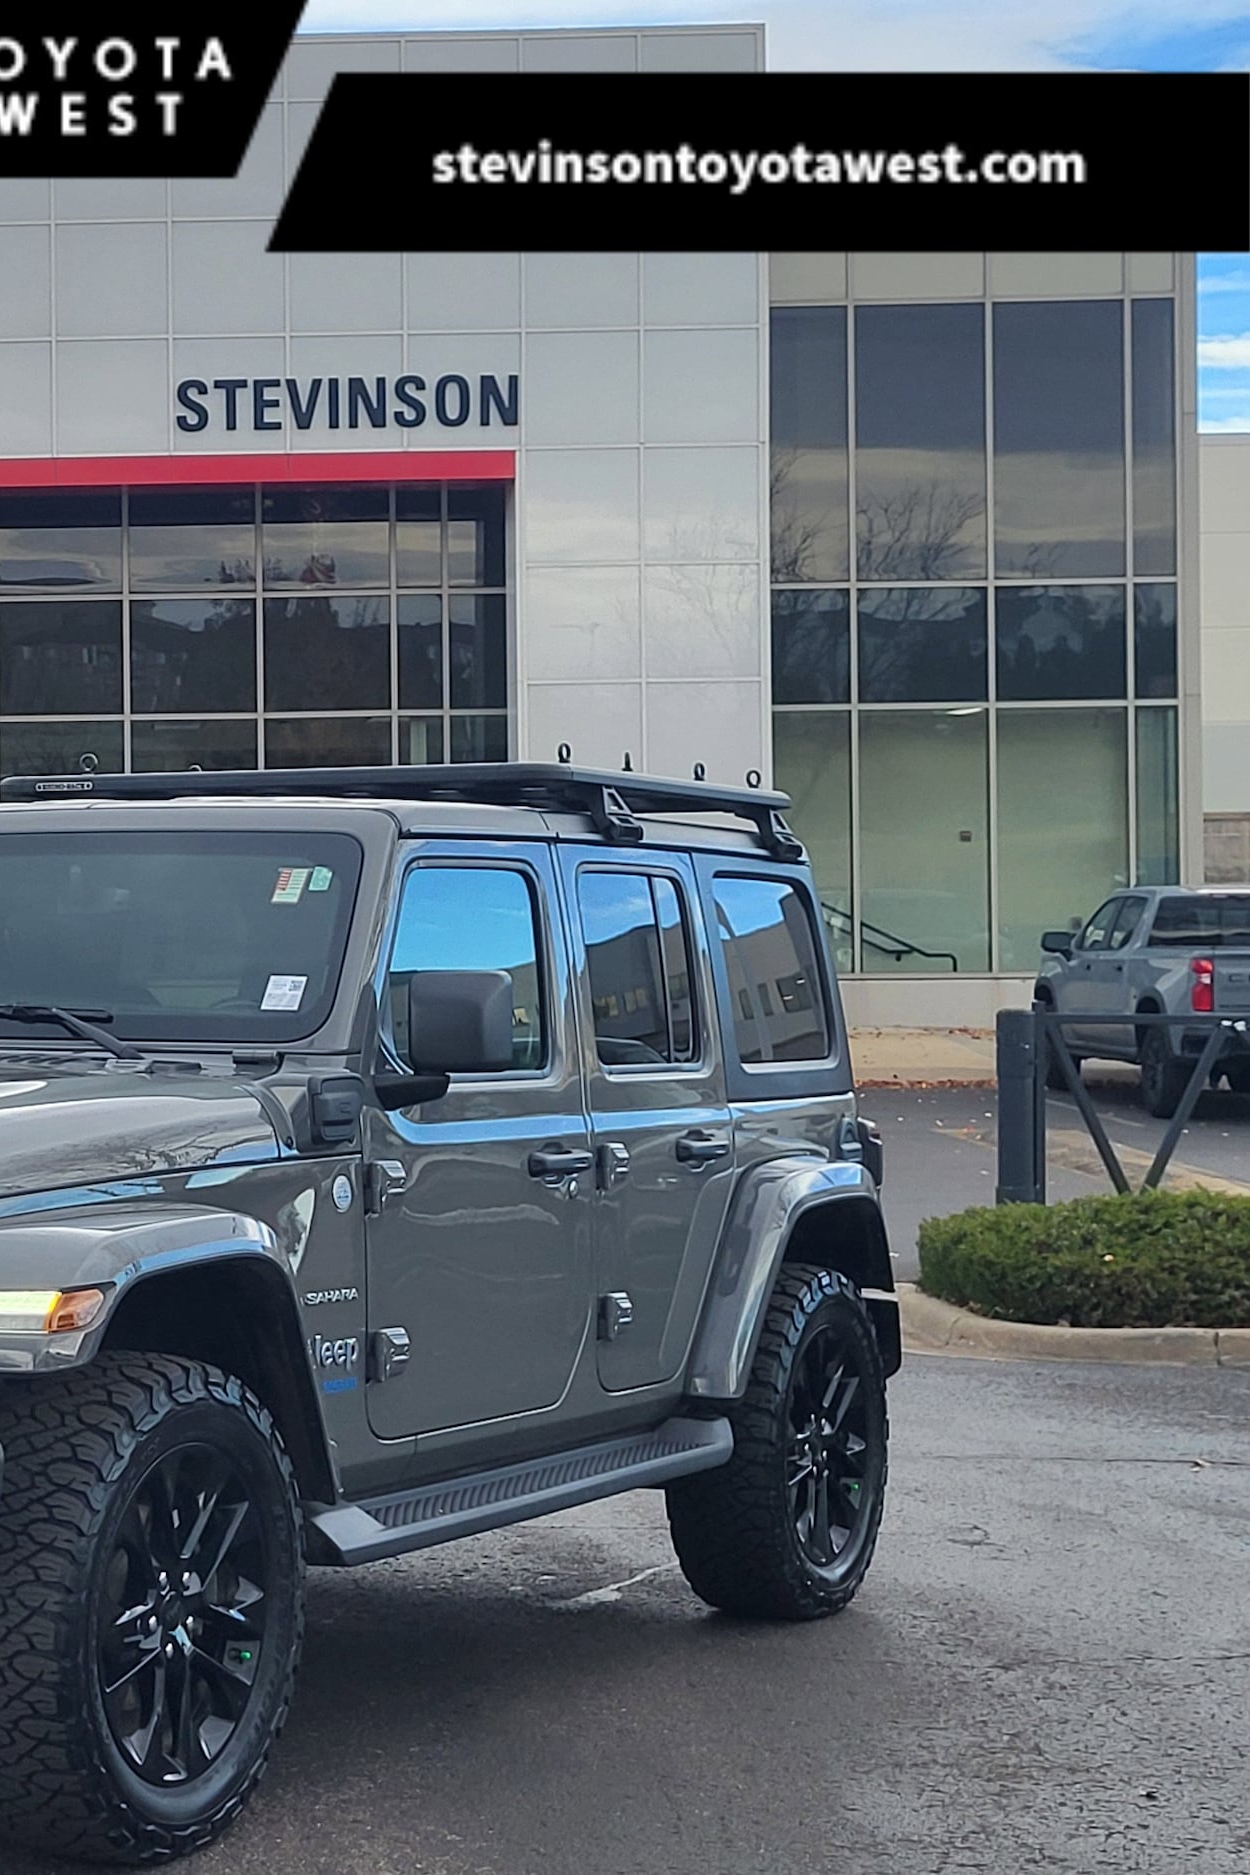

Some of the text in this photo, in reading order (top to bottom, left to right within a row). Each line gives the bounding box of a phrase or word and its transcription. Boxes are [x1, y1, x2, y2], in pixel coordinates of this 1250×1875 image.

[176, 374, 519, 432] STEVINSON
[305, 1288, 359, 1305] SAHARA
[313, 1335, 359, 1371] Jeep
